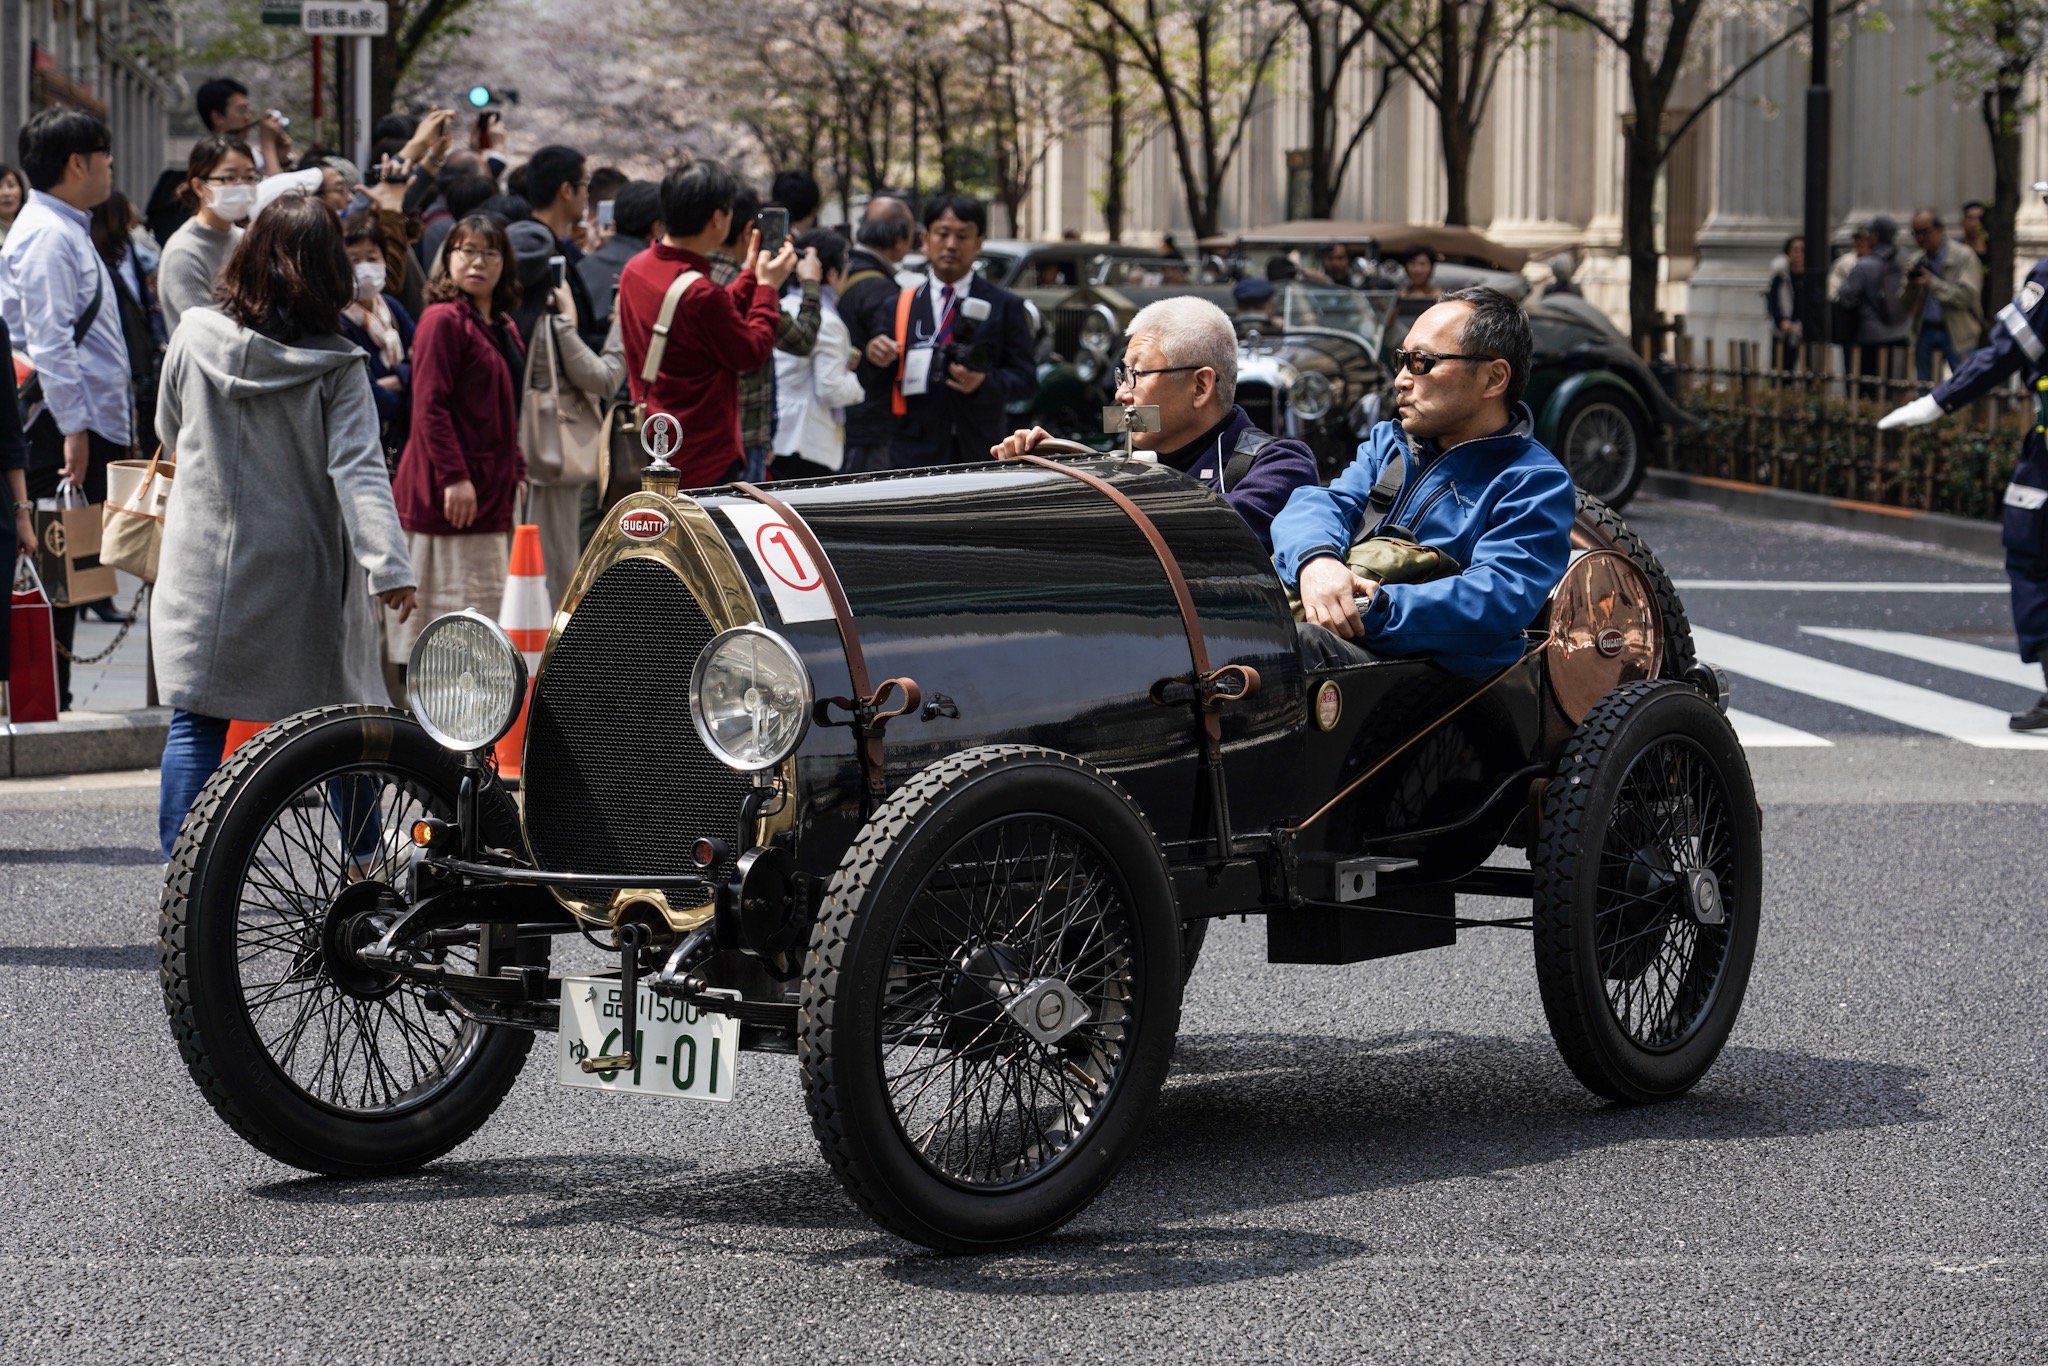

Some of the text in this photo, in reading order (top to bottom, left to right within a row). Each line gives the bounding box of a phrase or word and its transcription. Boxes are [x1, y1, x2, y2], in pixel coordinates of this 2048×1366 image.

[307, 8, 382, 28] 自転車を除く
[623, 520, 663, 532] BUGATTI
[568, 1027, 721, 1094] ゆ 61-01
